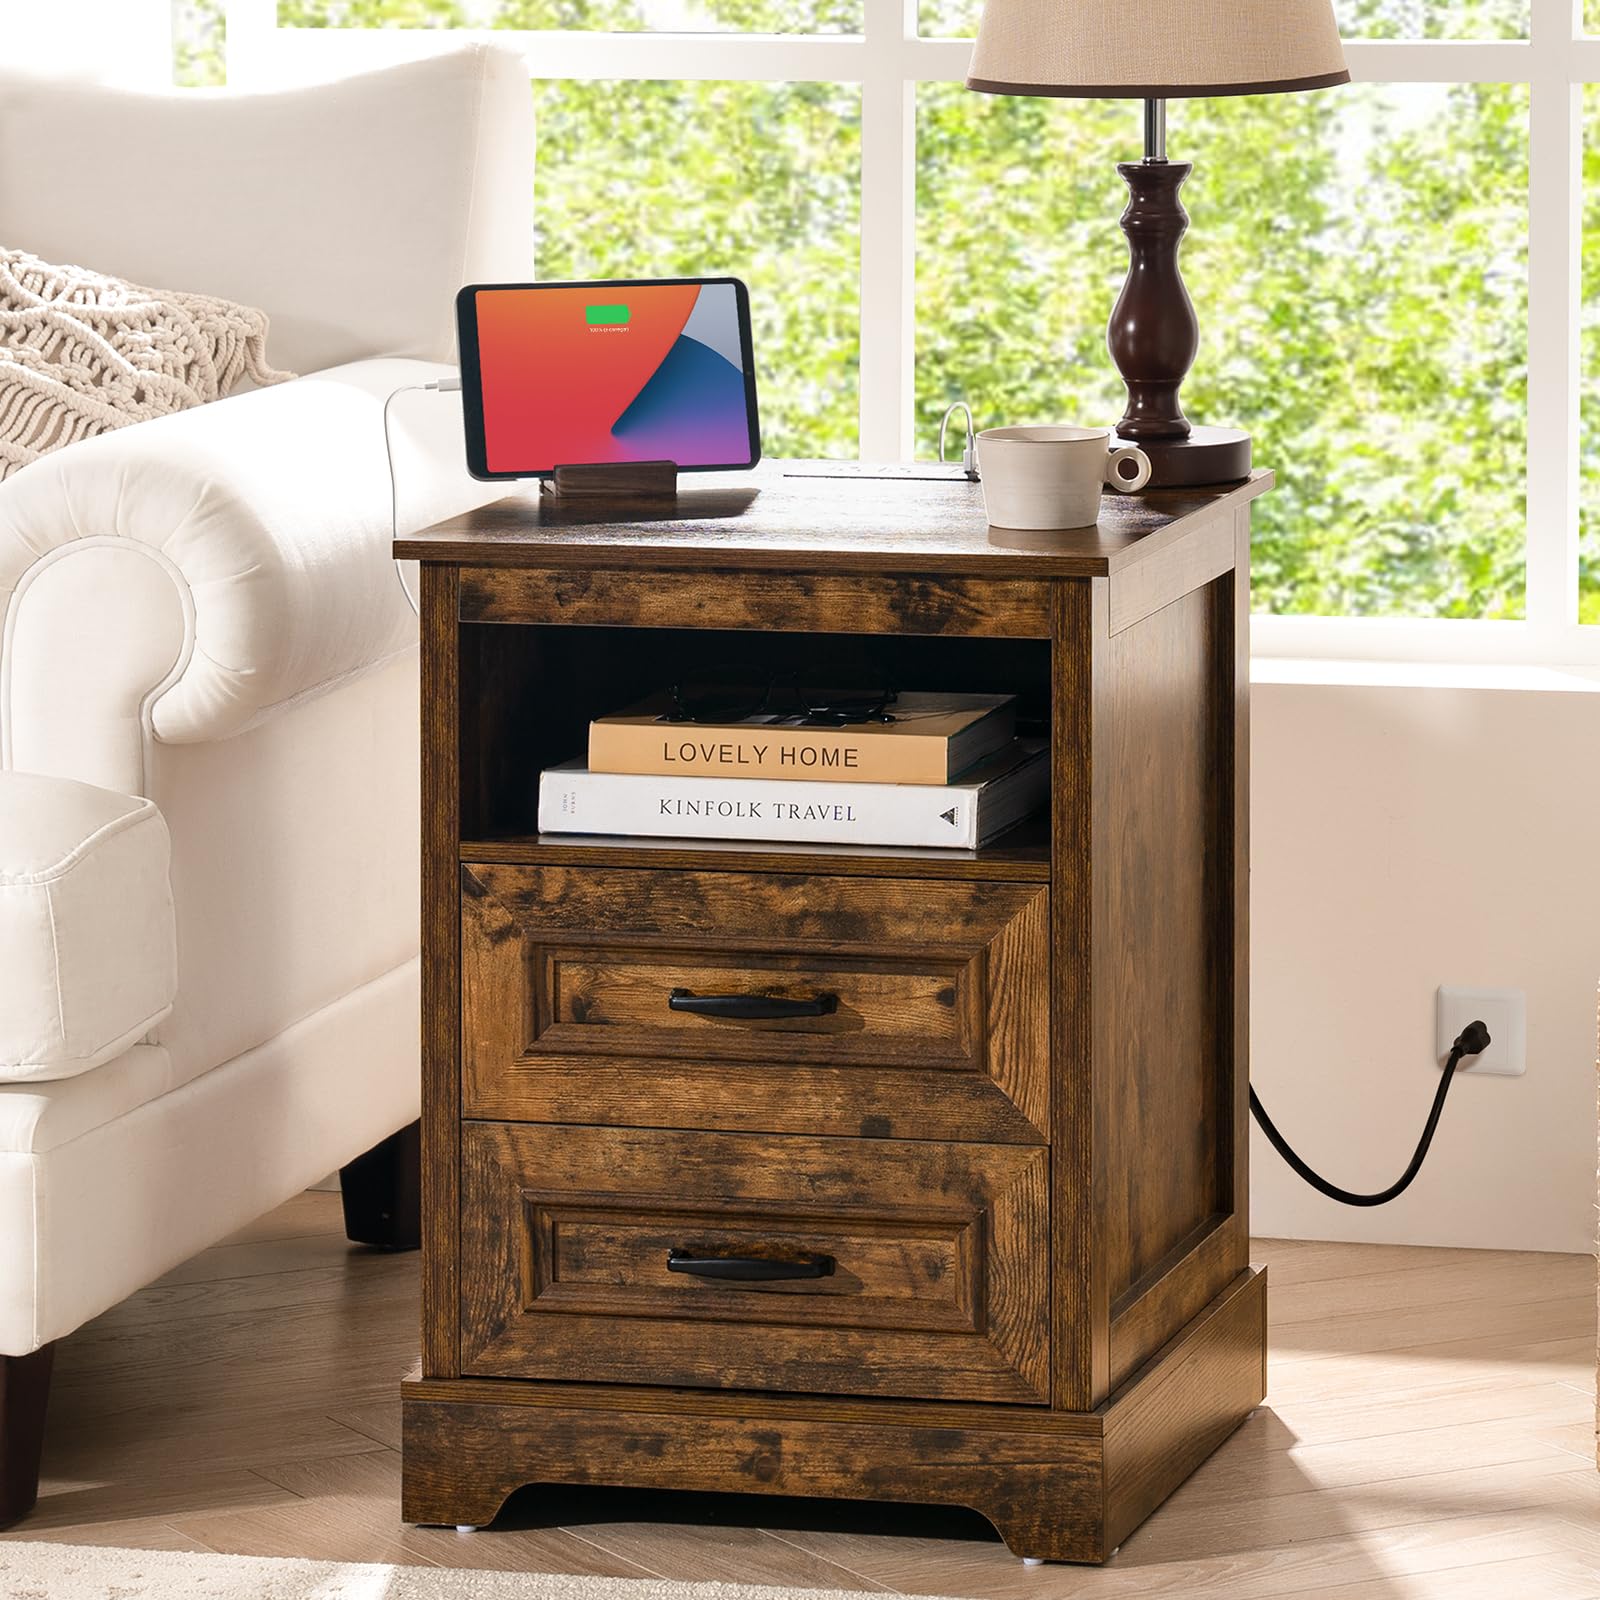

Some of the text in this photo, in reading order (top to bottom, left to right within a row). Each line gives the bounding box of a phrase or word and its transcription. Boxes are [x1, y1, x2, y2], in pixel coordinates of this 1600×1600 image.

[664, 742, 859, 768] LOVELY HOME
[659, 798, 857, 821] KINFOLK TRAVEL
